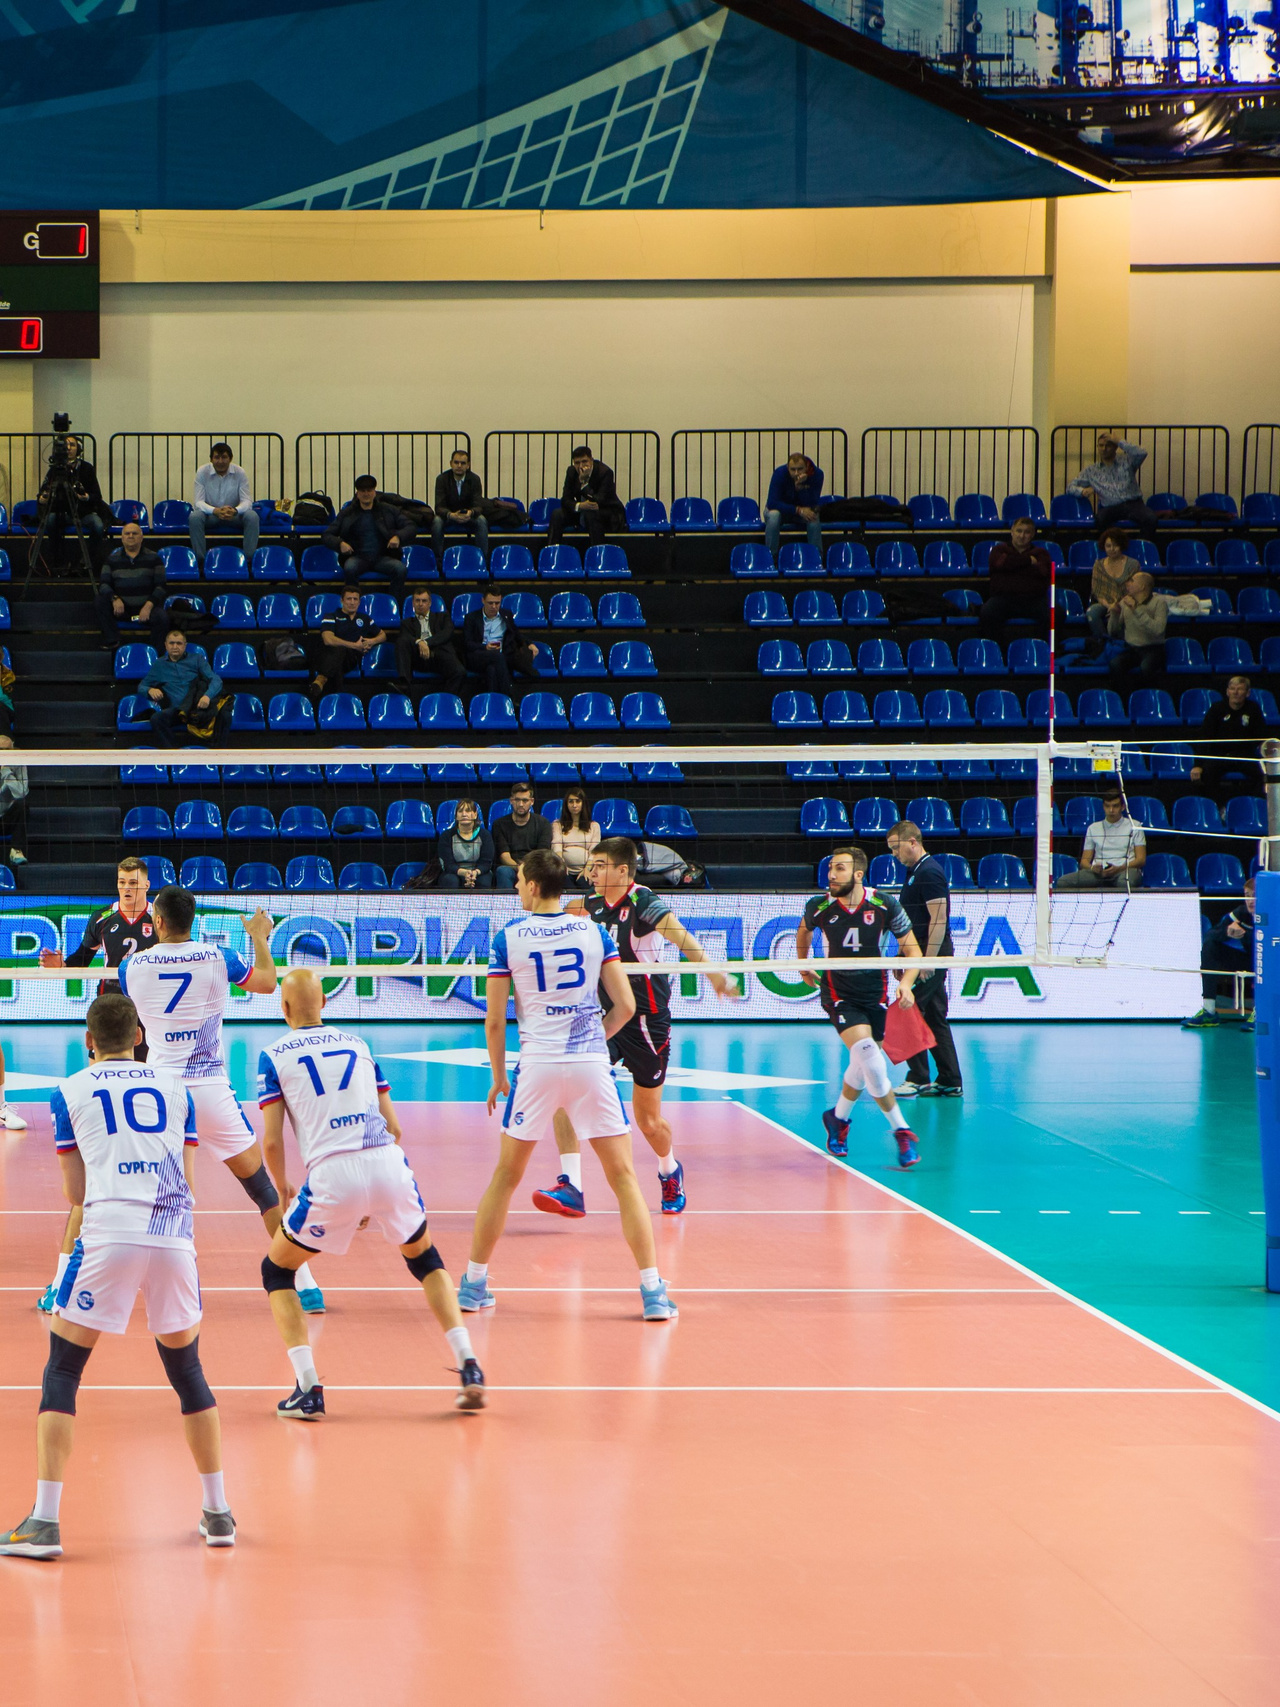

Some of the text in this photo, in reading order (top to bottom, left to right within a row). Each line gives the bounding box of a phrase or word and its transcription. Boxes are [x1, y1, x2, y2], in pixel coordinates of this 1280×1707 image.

[23, 227, 87, 254] G 1
[21, 320, 40, 350] 0
[518, 922, 588, 937] ГЛИВЕНКО
[842, 927, 863, 952] 4
[122, 937, 138, 961] 2
[132, 950, 218, 966] КРСМАНОВИЧ
[528, 947, 586, 993] 13
[158, 972, 193, 1014] 7
[164, 1030, 198, 1043] СУРГУТ
[90, 1069, 156, 1080] УРСОВ
[297, 1049, 358, 1097] 17
[91, 1087, 167, 1136] 10
[329, 1113, 366, 1130] СУРГУТ
[118, 1161, 160, 1175] СУРГУТ
